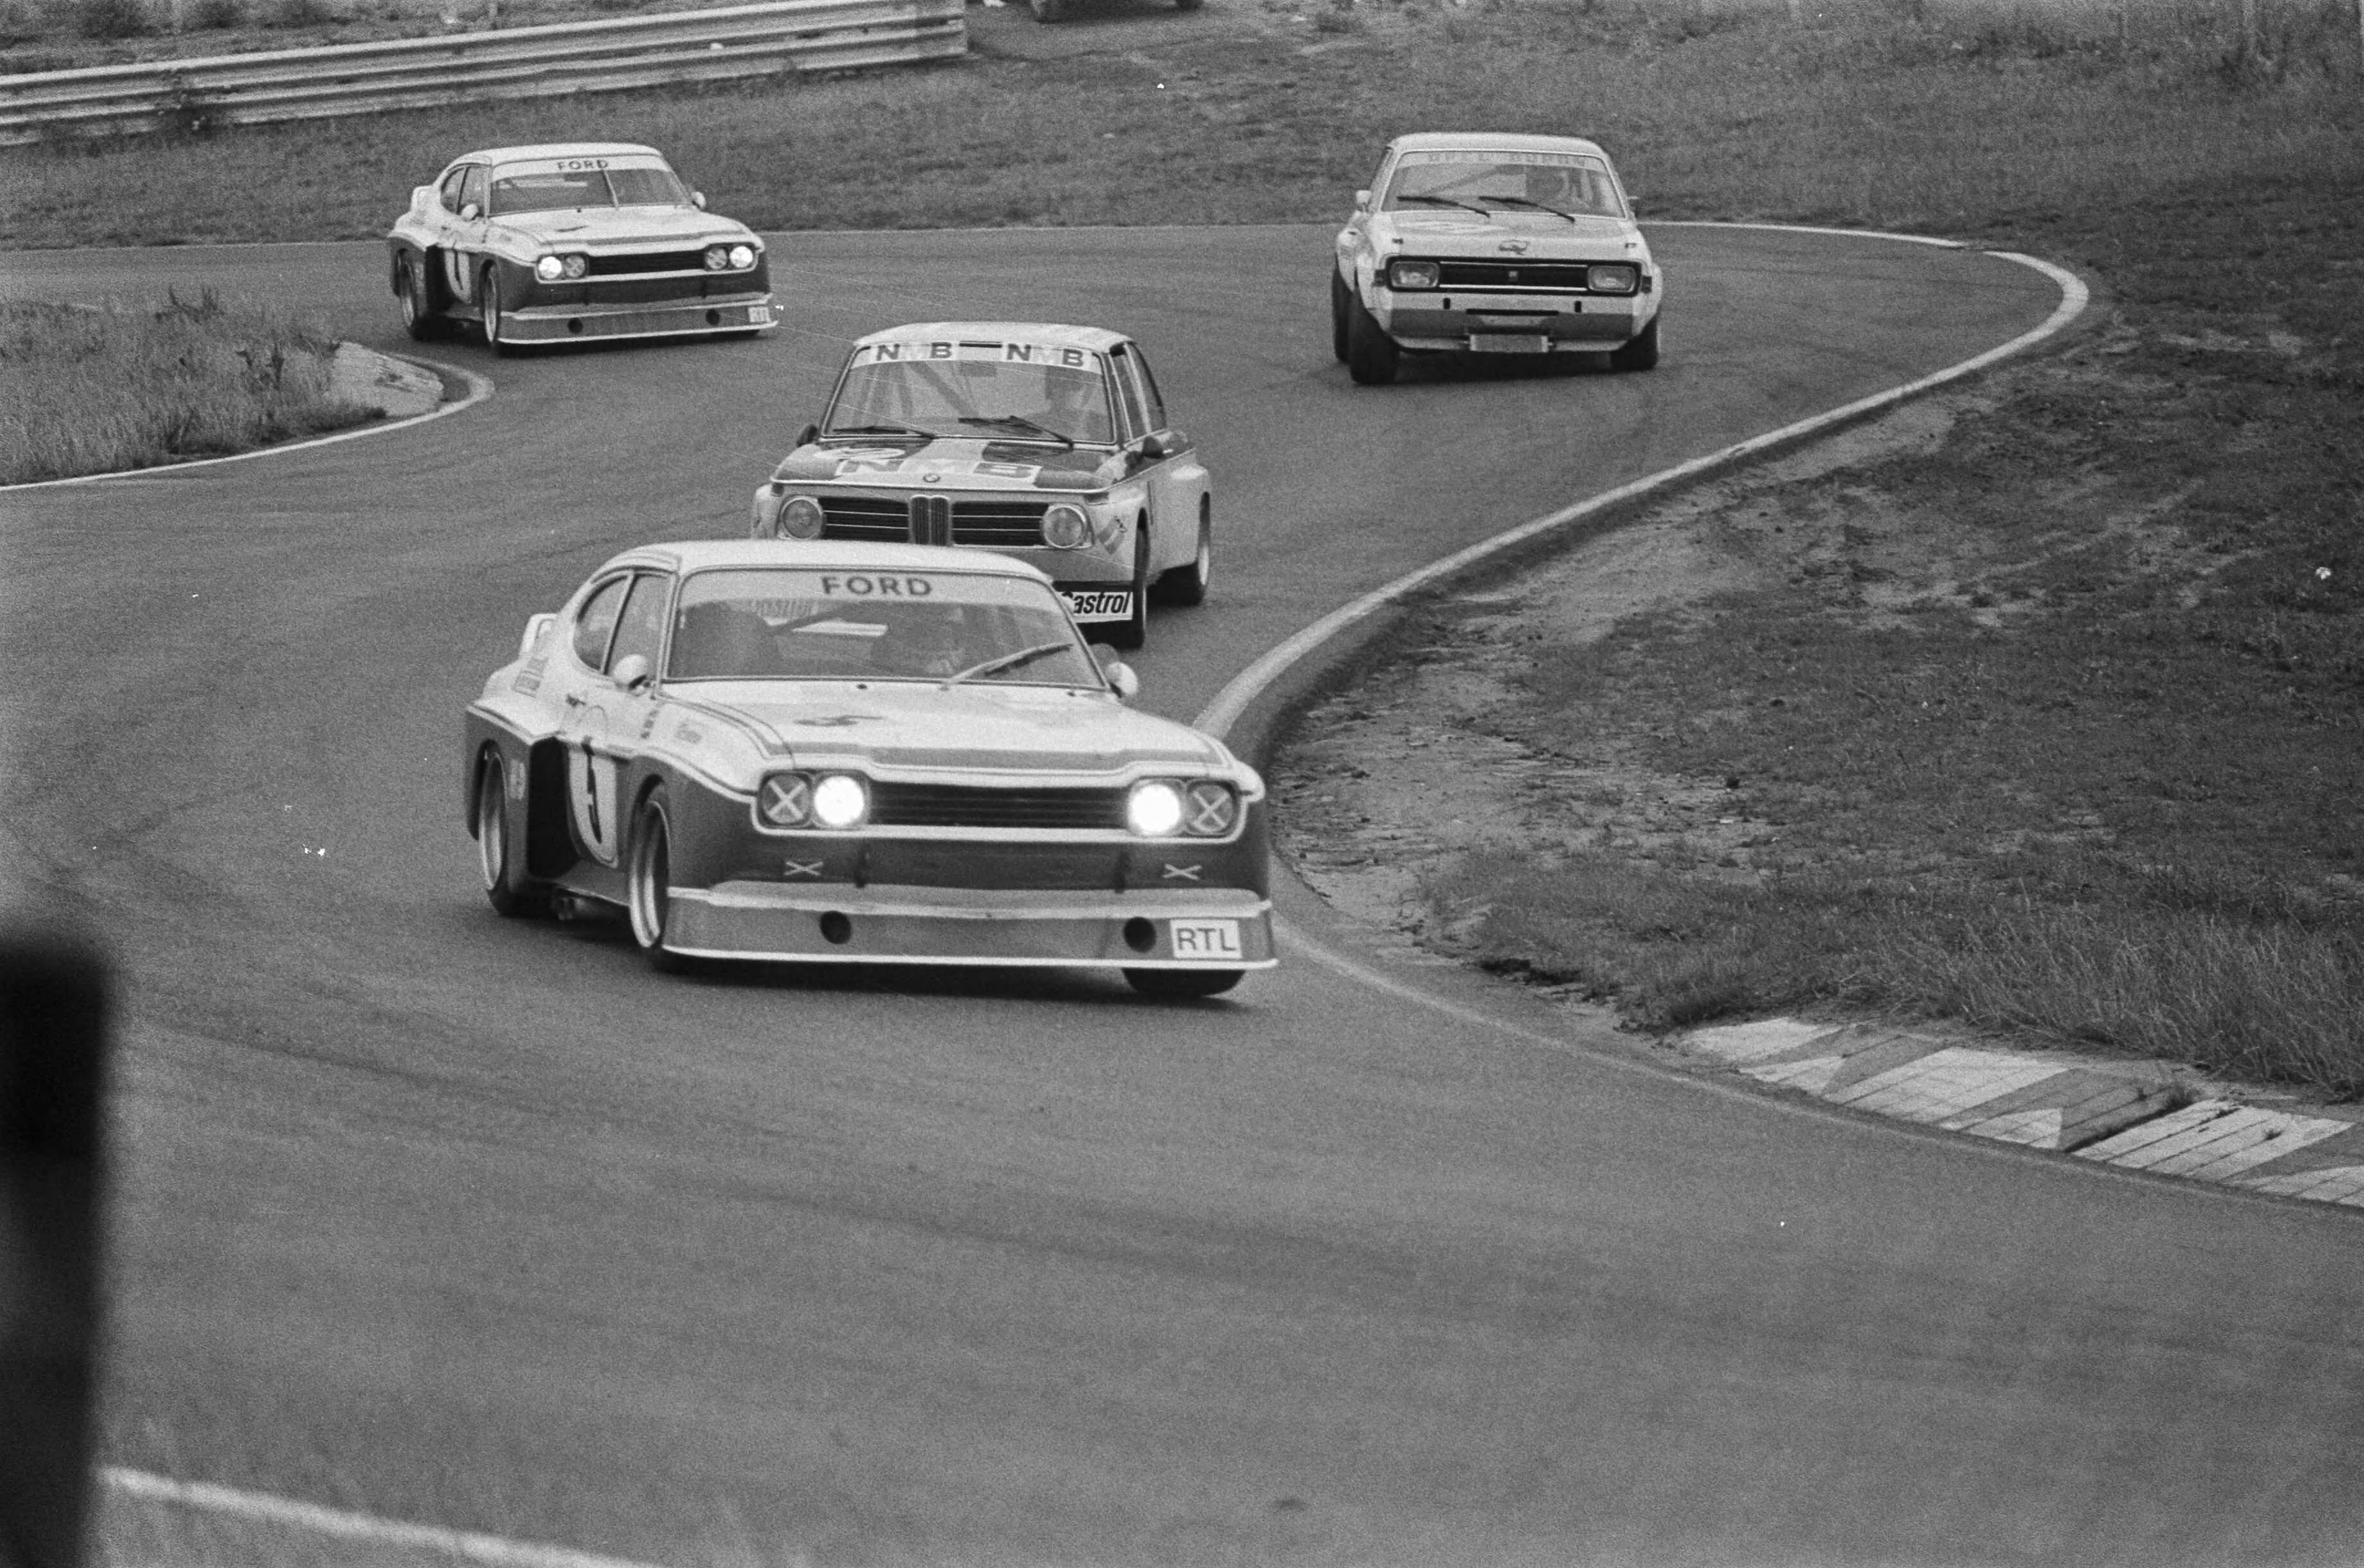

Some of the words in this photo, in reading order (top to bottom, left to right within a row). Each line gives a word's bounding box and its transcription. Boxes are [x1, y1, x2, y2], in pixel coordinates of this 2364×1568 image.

[557, 159, 608, 170] FORD
[822, 576, 932, 596] FORD
[1176, 928, 1237, 951] RTL
